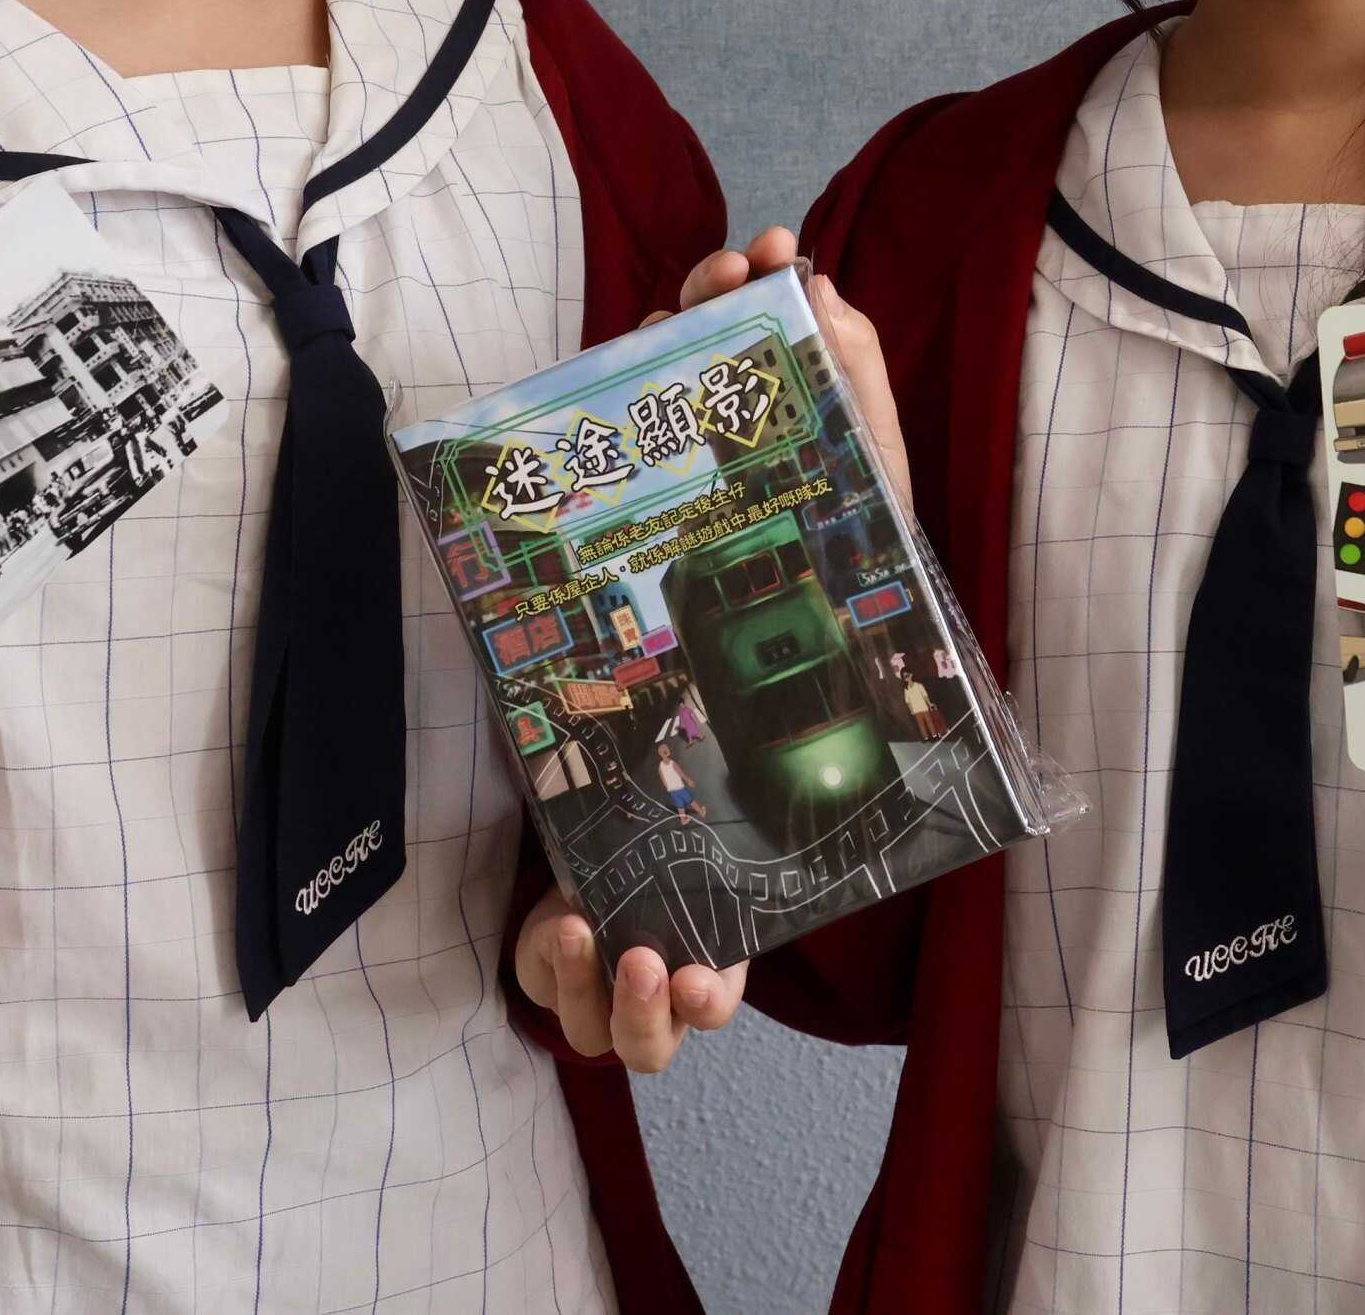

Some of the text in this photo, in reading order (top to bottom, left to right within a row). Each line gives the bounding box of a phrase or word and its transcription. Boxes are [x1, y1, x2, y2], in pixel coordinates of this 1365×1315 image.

[485, 357, 770, 521] 迷途顯影
[577, 481, 747, 564] 無論係老友記定後生仔
